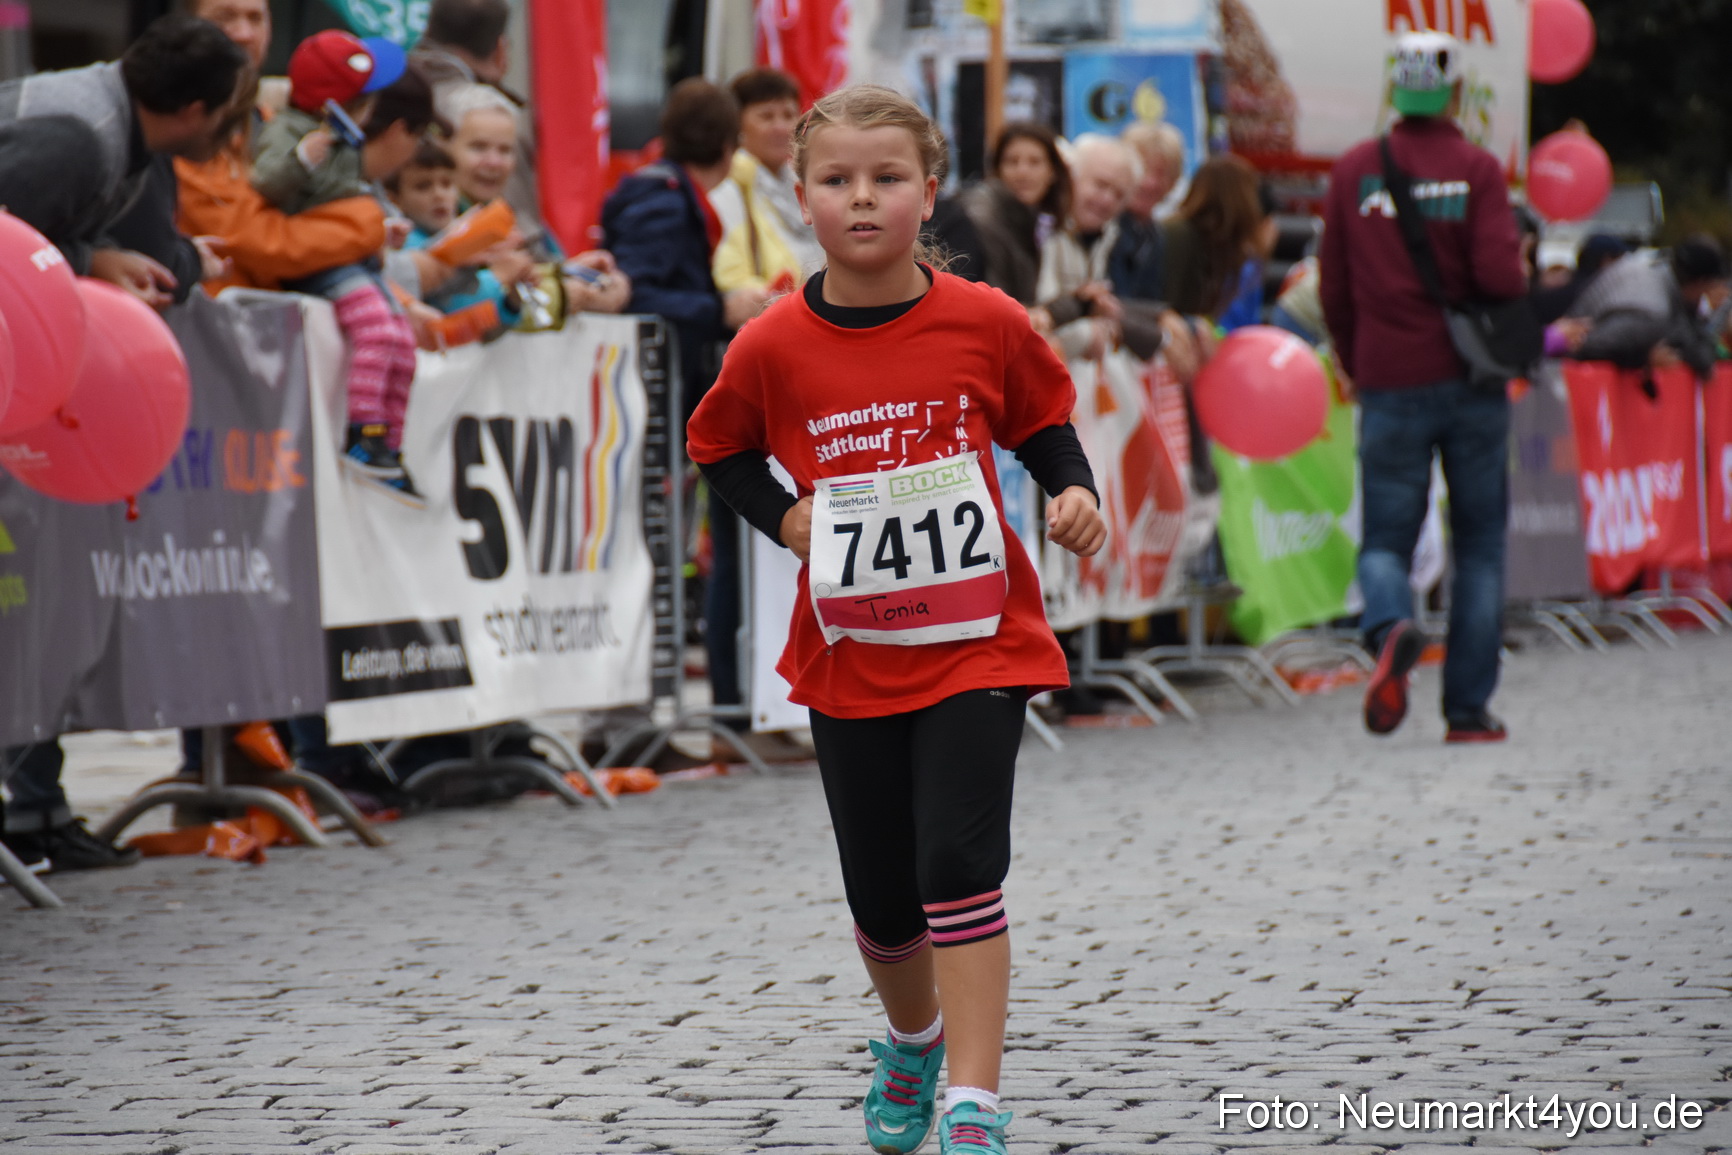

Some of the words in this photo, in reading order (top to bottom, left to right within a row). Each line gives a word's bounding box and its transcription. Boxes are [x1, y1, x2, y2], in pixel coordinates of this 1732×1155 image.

[806, 401, 918, 437] Neumarkter
[888, 461, 972, 499] BOCK
[828, 494, 880, 509] NeuerMarkt
[891, 496, 921, 506] inspired
[921, 493, 930, 502] by
[932, 489, 952, 499] smart
[833, 500, 991, 587] 7412
[993, 557, 1000, 569] K
[855, 595, 930, 623] Tonia
